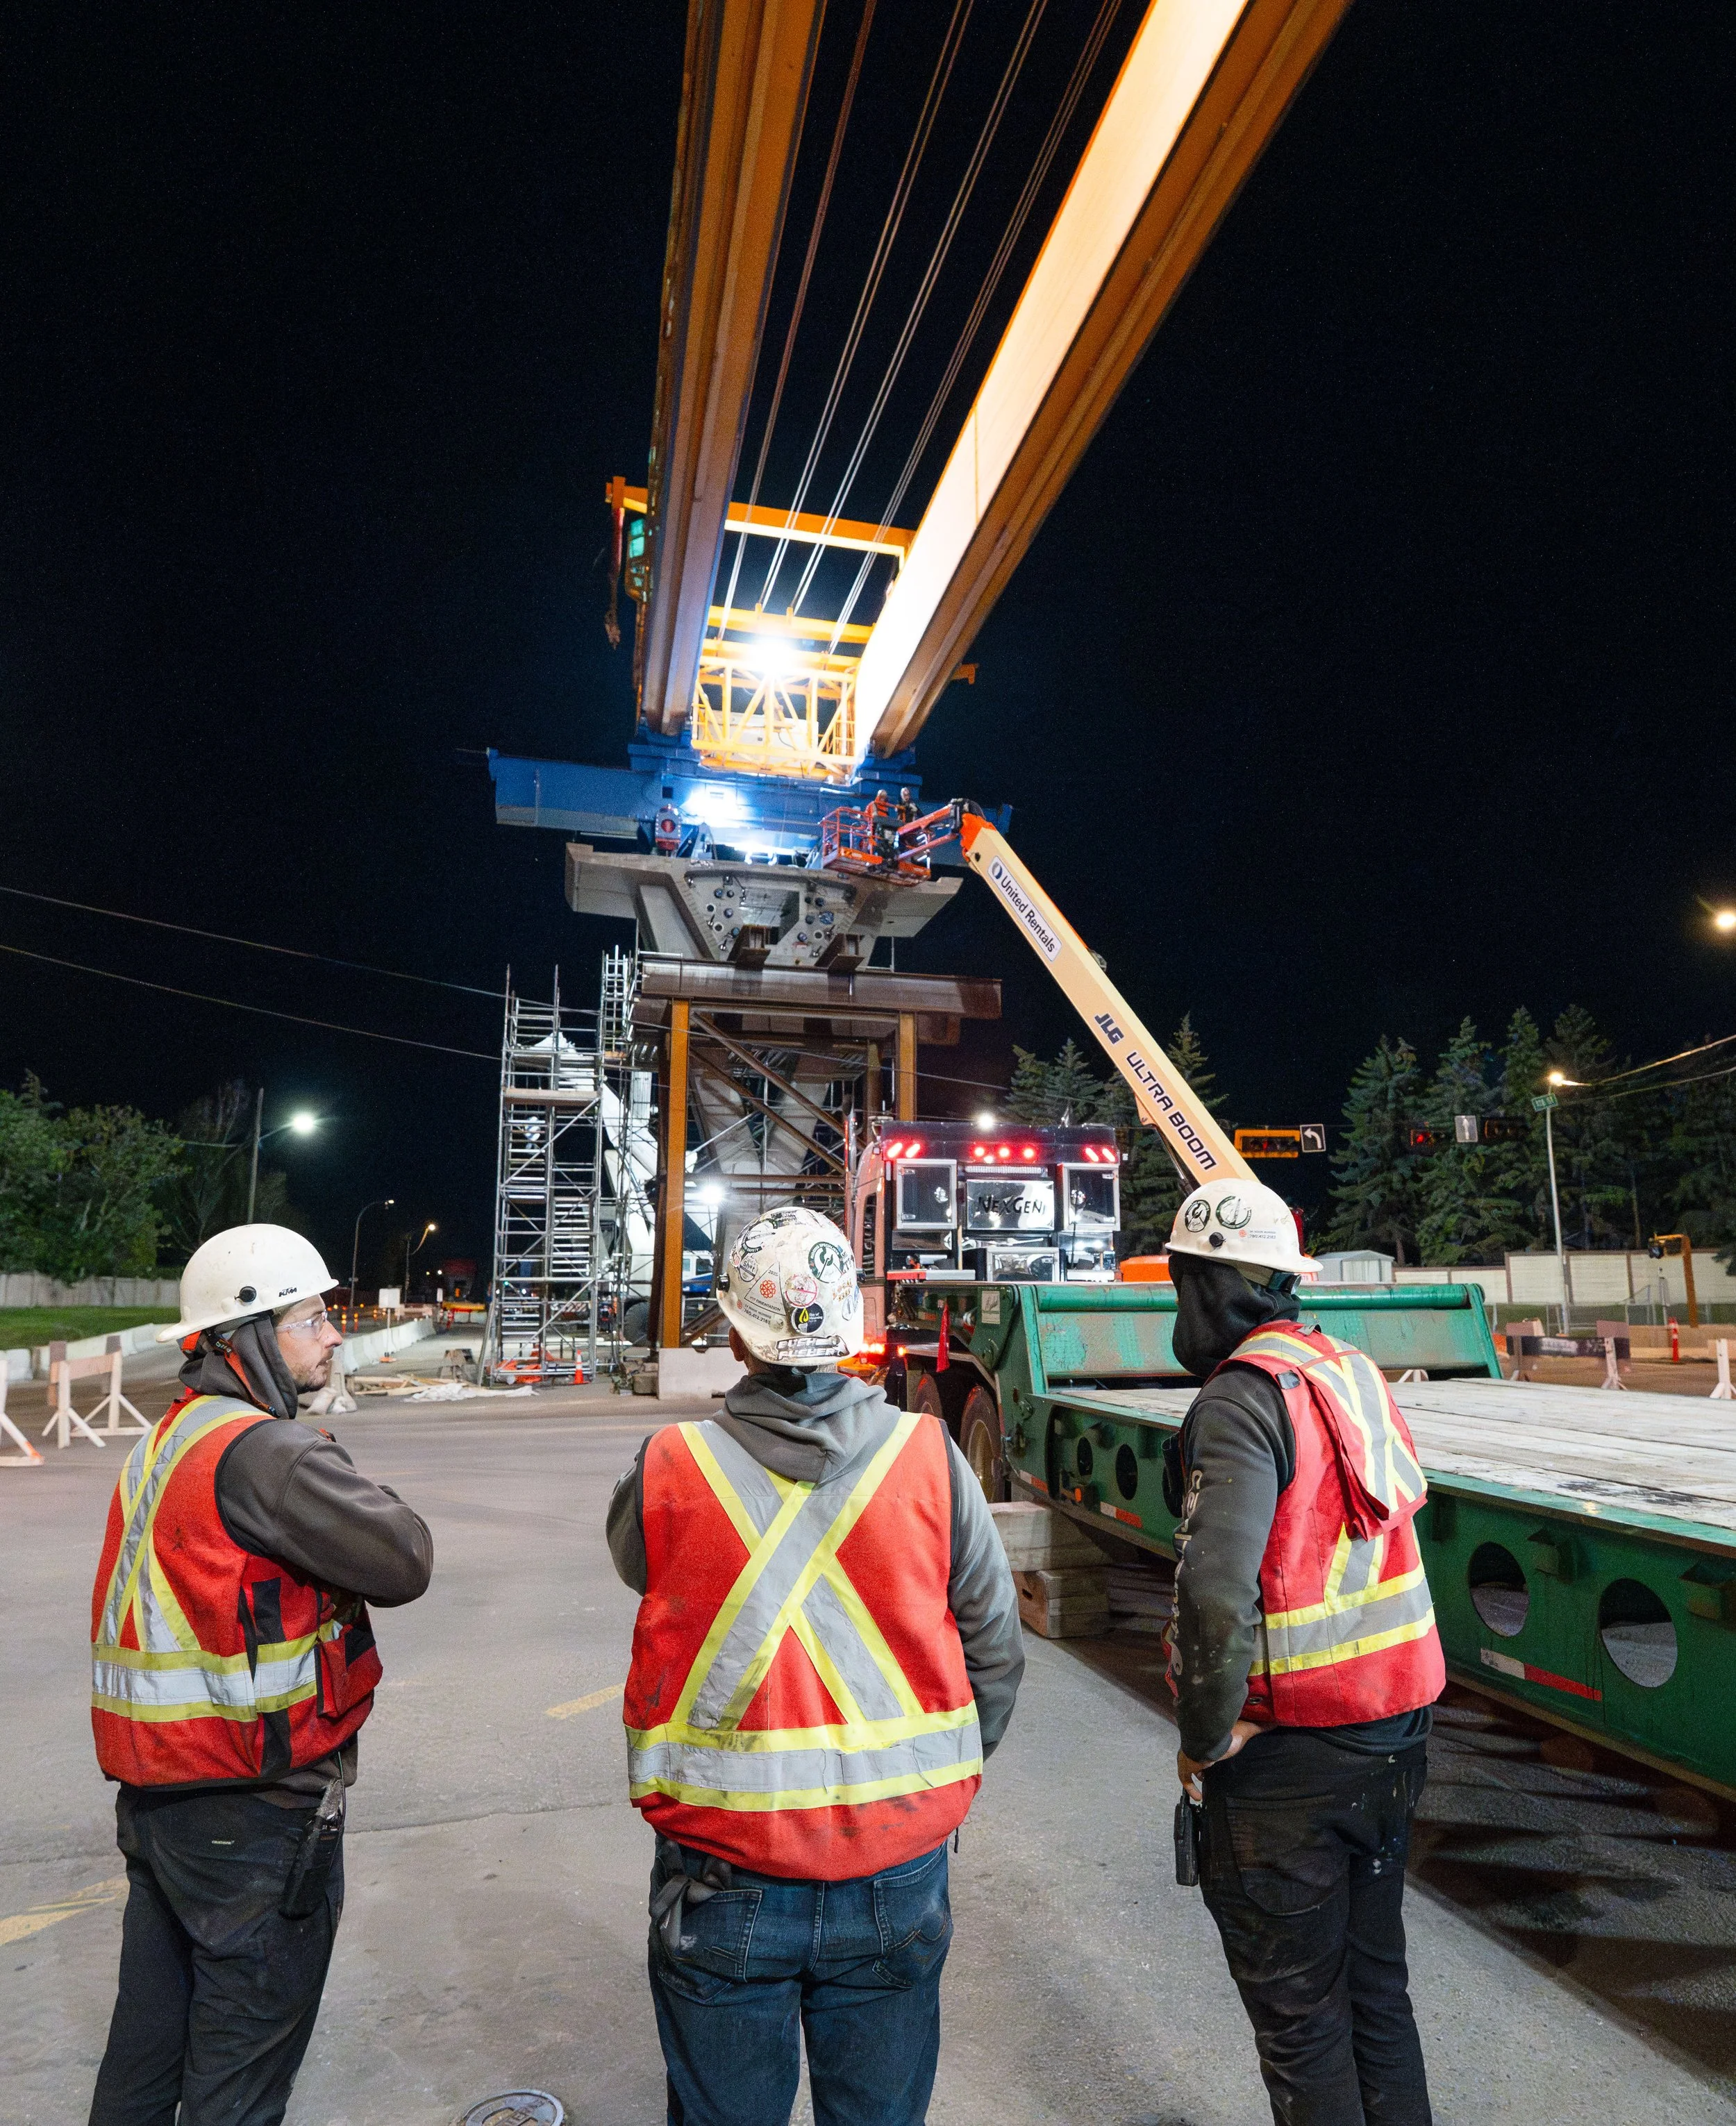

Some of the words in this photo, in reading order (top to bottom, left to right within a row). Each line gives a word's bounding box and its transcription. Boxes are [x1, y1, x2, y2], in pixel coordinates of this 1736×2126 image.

[1001, 876, 1028, 913] United
[1025, 910, 1055, 953] Rentals
[1094, 1013, 1125, 1044] JLG
[1126, 1051, 1174, 1112] ULTRA
[1168, 1111, 1217, 1171] BOOM
